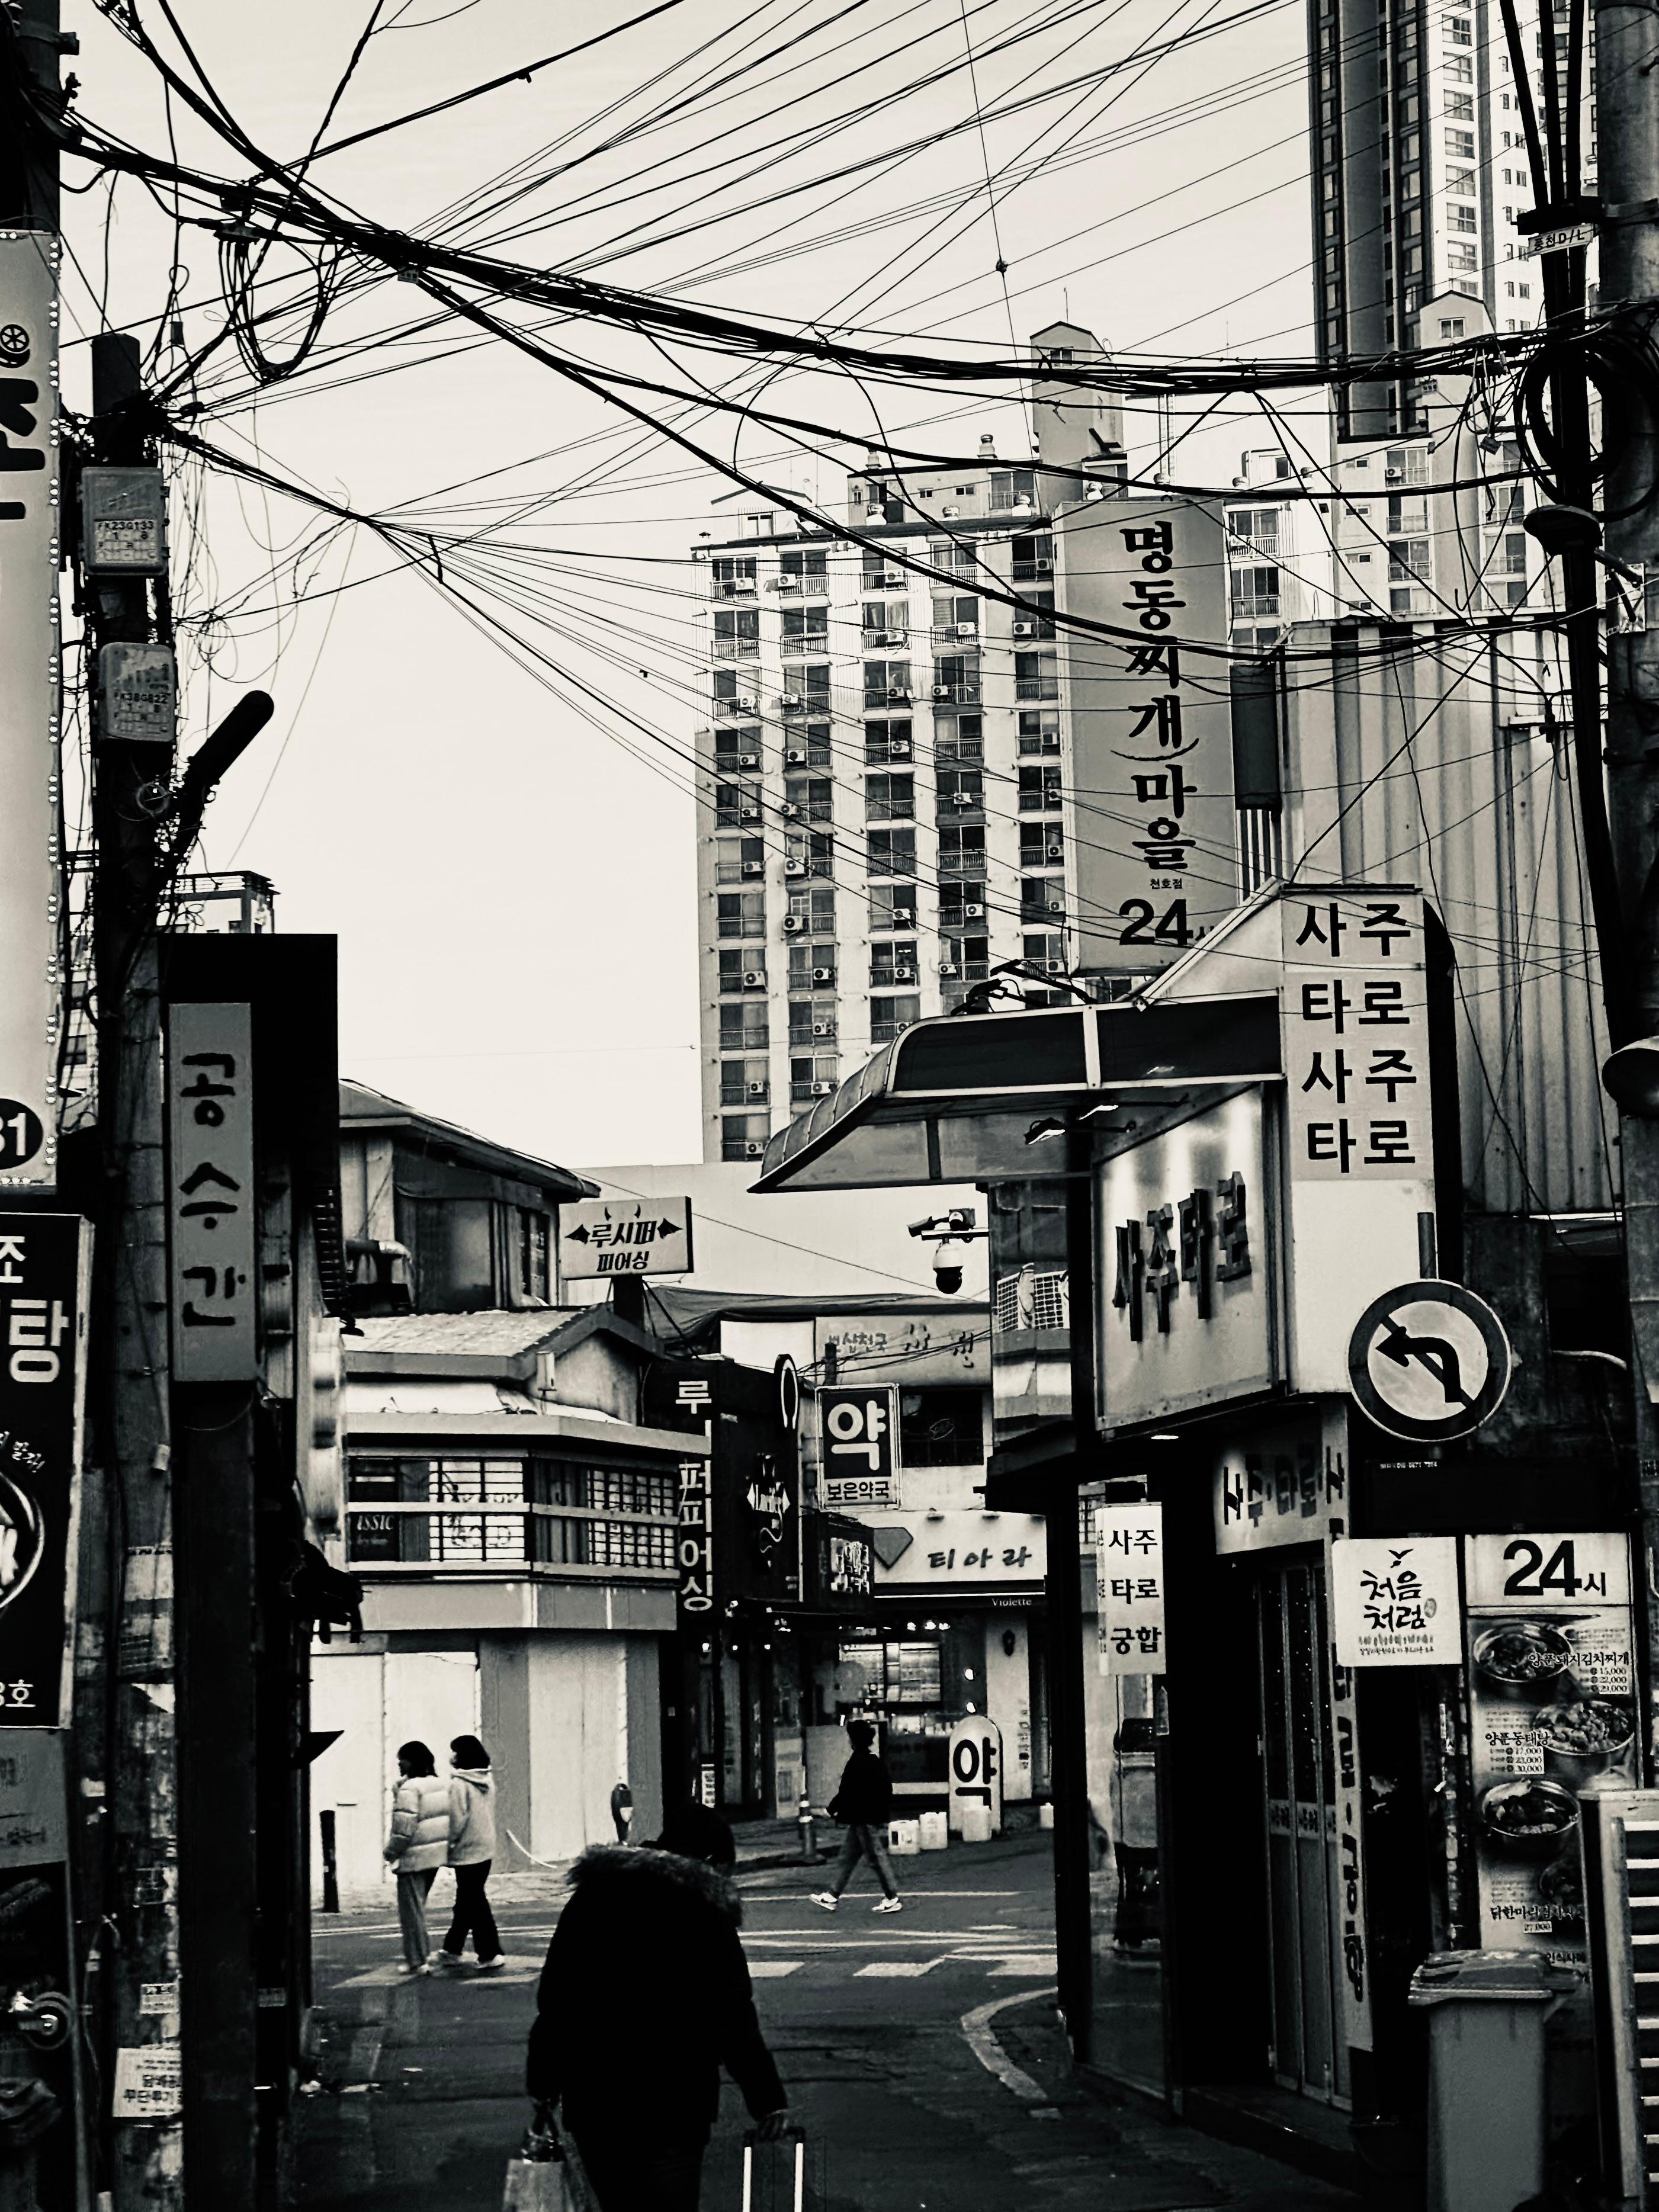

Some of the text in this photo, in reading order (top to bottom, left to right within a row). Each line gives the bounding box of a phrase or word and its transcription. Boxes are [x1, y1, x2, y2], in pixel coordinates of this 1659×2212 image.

[1119, 520, 1197, 870] 명동찌개마을
[1150, 878, 1183, 890] 천호점
[1295, 903, 1411, 957] 사주
[1302, 980, 1410, 1033] 타로
[1302, 1048, 1417, 1104] 사주
[1307, 1118, 1416, 1173] 타로
[179, 1052, 246, 1327] 공수간
[590, 1221, 657, 1248] 루시퍼
[596, 1251, 649, 1272] 피어싱
[828, 1400, 885, 1471] 약
[827, 1481, 888, 1501] 보은약국
[1109, 1530, 1157, 1555] 사주
[928, 1546, 1032, 1569] 티아라
[1503, 1540, 1607, 1596] 24시
[1111, 1579, 1160, 1604] 타로
[1360, 1570, 1423, 1601] 처음
[992, 1598, 1032, 1606] Violette
[1363, 1604, 1426, 1633] 처럼
[1111, 1627, 1161, 1655] 궁합
[1485, 1731, 1551, 1746] 양푼동태탕
[953, 1737, 996, 1810] 약
